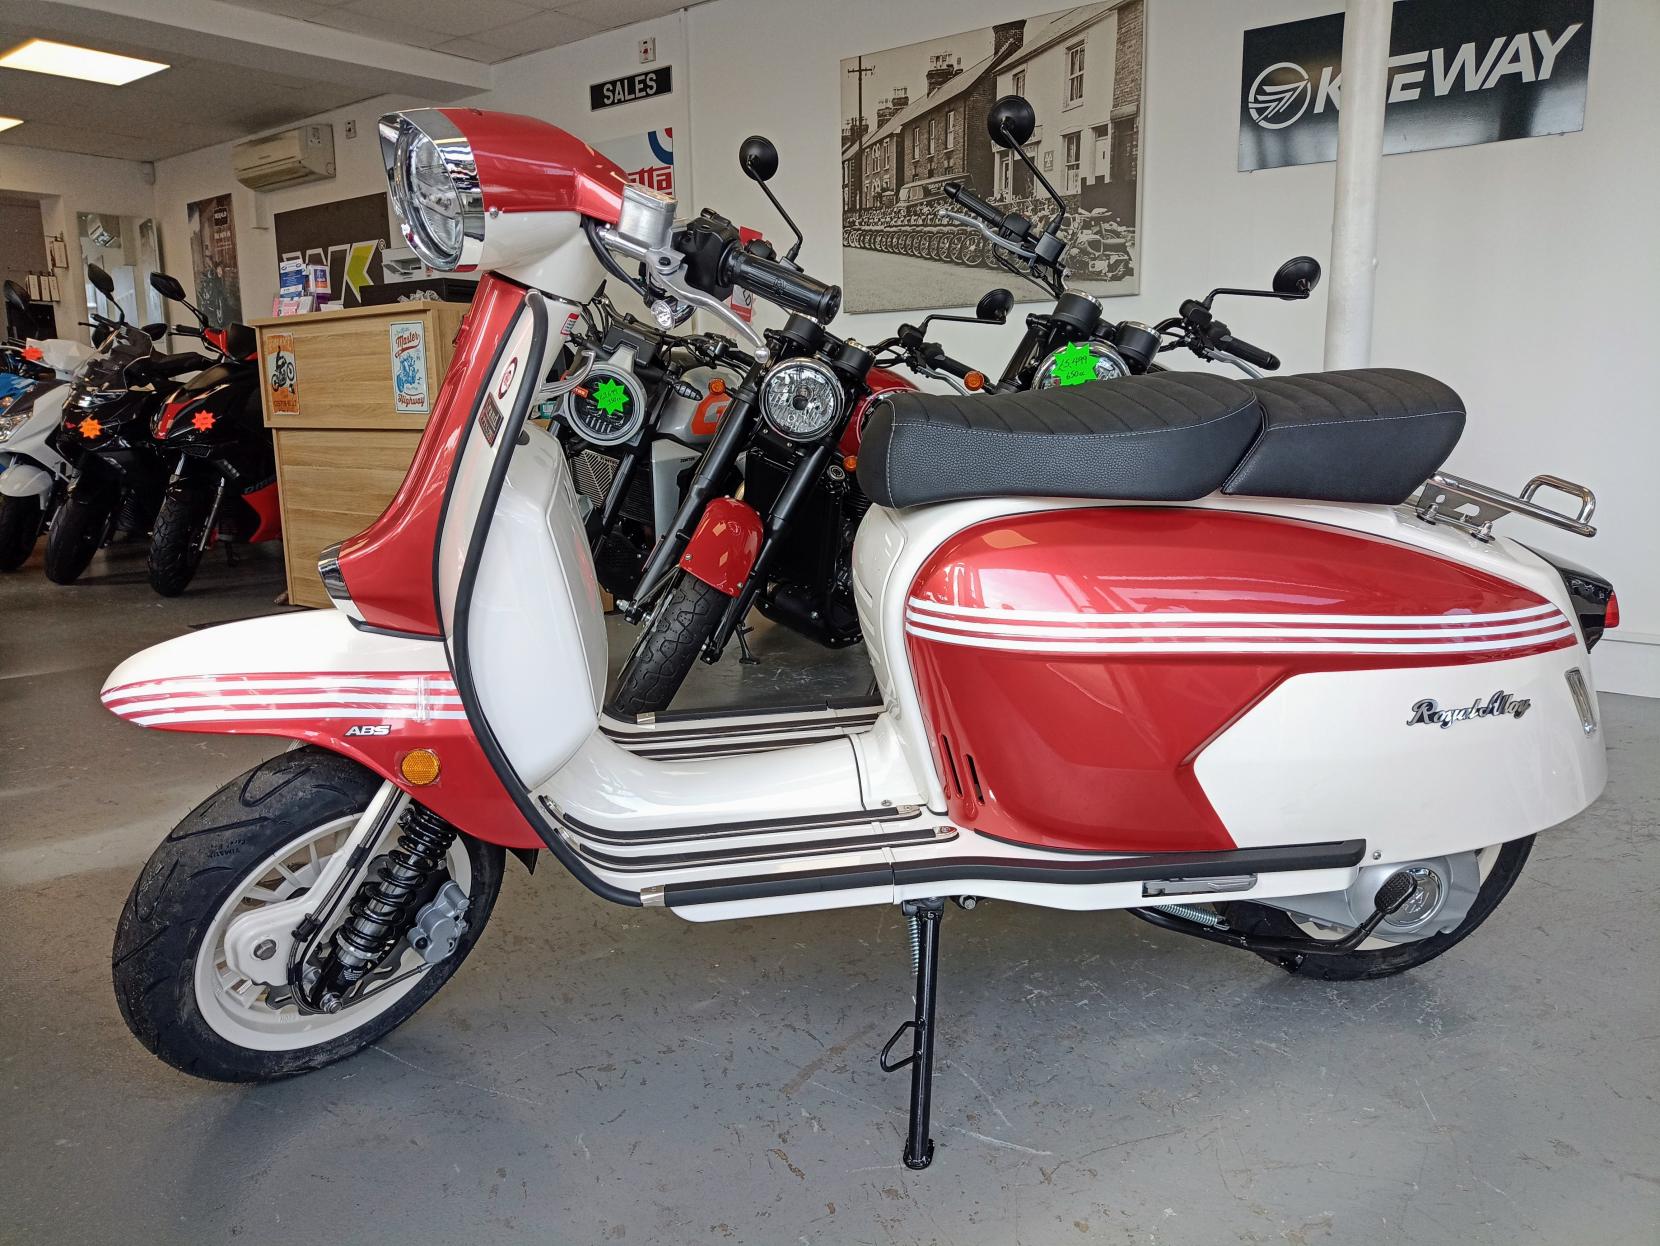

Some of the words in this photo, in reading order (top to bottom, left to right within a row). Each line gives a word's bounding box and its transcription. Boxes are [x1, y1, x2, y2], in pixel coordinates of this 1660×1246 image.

[1313, 22, 1584, 114] KEWAY
[603, 73, 657, 105] SALES
[397, 393, 425, 408] Highway
[1406, 699, 1482, 729] Royal
[1478, 690, 1531, 719] Alloy
[344, 724, 392, 737] ABS
